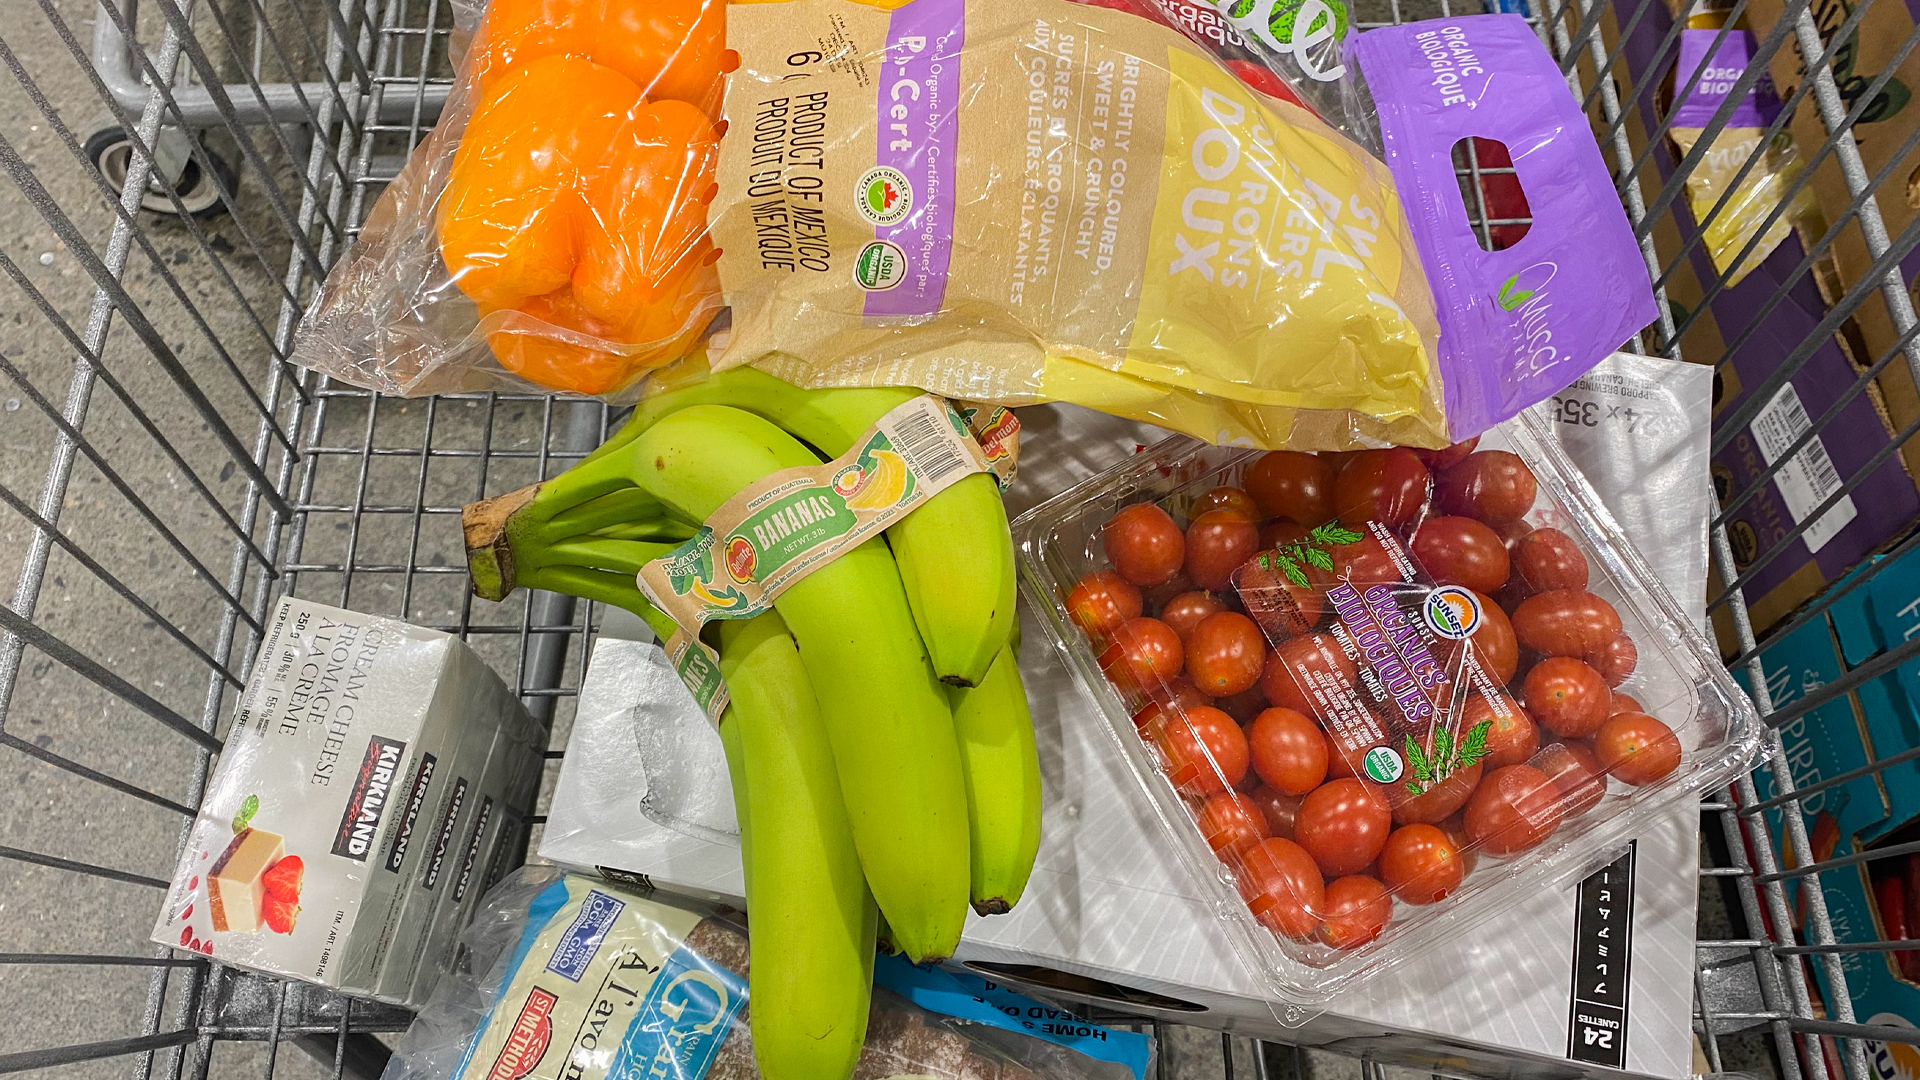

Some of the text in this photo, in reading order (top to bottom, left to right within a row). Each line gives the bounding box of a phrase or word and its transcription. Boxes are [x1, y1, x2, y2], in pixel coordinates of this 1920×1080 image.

[1415, 30, 1466, 107] BIOLOGIQUE
[1440, 26, 1484, 77] ORGANIC
[925, 64, 942, 110] Organic
[1052, 34, 1074, 110] SUCRÉS
[889, 36, 926, 152] P-Cert
[788, 91, 829, 170] PRODUCT
[925, 113, 942, 133] by:
[926, 146, 940, 200] Certifiés
[1010, 18, 1050, 306] AUX COULEURS ÉCLATANTES
[1074, 60, 1115, 260] SWEET & CRUNCHY
[1090, 55, 1140, 276] BRIGHTLY COLOURED,
[747, 96, 796, 273] PRODUIT DU MEXIQUE
[788, 176, 823, 202] OF
[862, 172, 908, 192] CANADA ORGANIC
[1169, 86, 1245, 283] DOUX
[878, 199, 908, 222] BIOLOGIQUE
[1030, 149, 1063, 284] CROQUANTS,
[791, 204, 830, 272] MEXICO
[920, 204, 939, 274] biologiques
[866, 248, 880, 284] ORGANIC
[880, 255, 894, 280] USDA
[1579, 380, 1661, 400] SAPPORO BREWING
[1624, 406, 1661, 436] 24
[890, 436, 907, 453] 30669
[982, 440, 998, 454] Del
[748, 478, 814, 510] PRODUCT OF GUATEMALA
[753, 495, 836, 552] BANANAS
[783, 528, 826, 555] NET WT. 3 lb
[1366, 520, 1414, 584] AND DO NOT REFRIGERATE
[1376, 522, 1417, 576] WASH BEFORE EATING
[279, 602, 292, 621] KEEP
[296, 612, 310, 632] 250
[318, 616, 342, 630] À
[1407, 609, 1438, 646] SUNSET
[1430, 594, 1464, 640] SUNSET
[290, 631, 300, 639] g
[308, 636, 331, 658] LA
[1326, 582, 1432, 723] BIOLOGIQUES
[1363, 584, 1446, 690] ORGANICS
[282, 650, 295, 663] 30
[306, 622, 361, 725] FROMAGE
[1329, 620, 1362, 662] TOMATOES
[1358, 666, 1388, 702] TOMATES
[249, 678, 262, 710] GARDER
[1466, 666, 1476, 676] NE
[1472, 674, 1483, 686] PAS
[1467, 652, 1514, 718] LAVER AVANT DE MANGER
[264, 696, 278, 710] 55
[278, 662, 320, 736] CRÈME
[311, 628, 383, 787] CREAM CHEESE
[1765, 664, 1827, 817] INPIRED
[1369, 754, 1390, 780] ORGANIC
[1379, 750, 1398, 774] USDA
[336, 740, 380, 851] Signature
[348, 744, 400, 856] KIRKLAND
[392, 760, 434, 868] KIRKLAND
[428, 784, 466, 886] KIRKLAND
[456, 803, 492, 899] KIRKLAND
[332, 910, 344, 926] ITM.
[580, 900, 604, 930] OGM
[1594, 861, 1612, 994] プレミアムビー
[326, 930, 337, 948] ART.
[560, 936, 580, 969] GMO
[573, 947, 586, 966] NON
[316, 946, 331, 978] 1498146
[534, 996, 549, 1015] ST
[1578, 1014, 1620, 1029] CANETTES
[1042, 1024, 1107, 1042] HOME
[1583, 1026, 1612, 1049] 24
